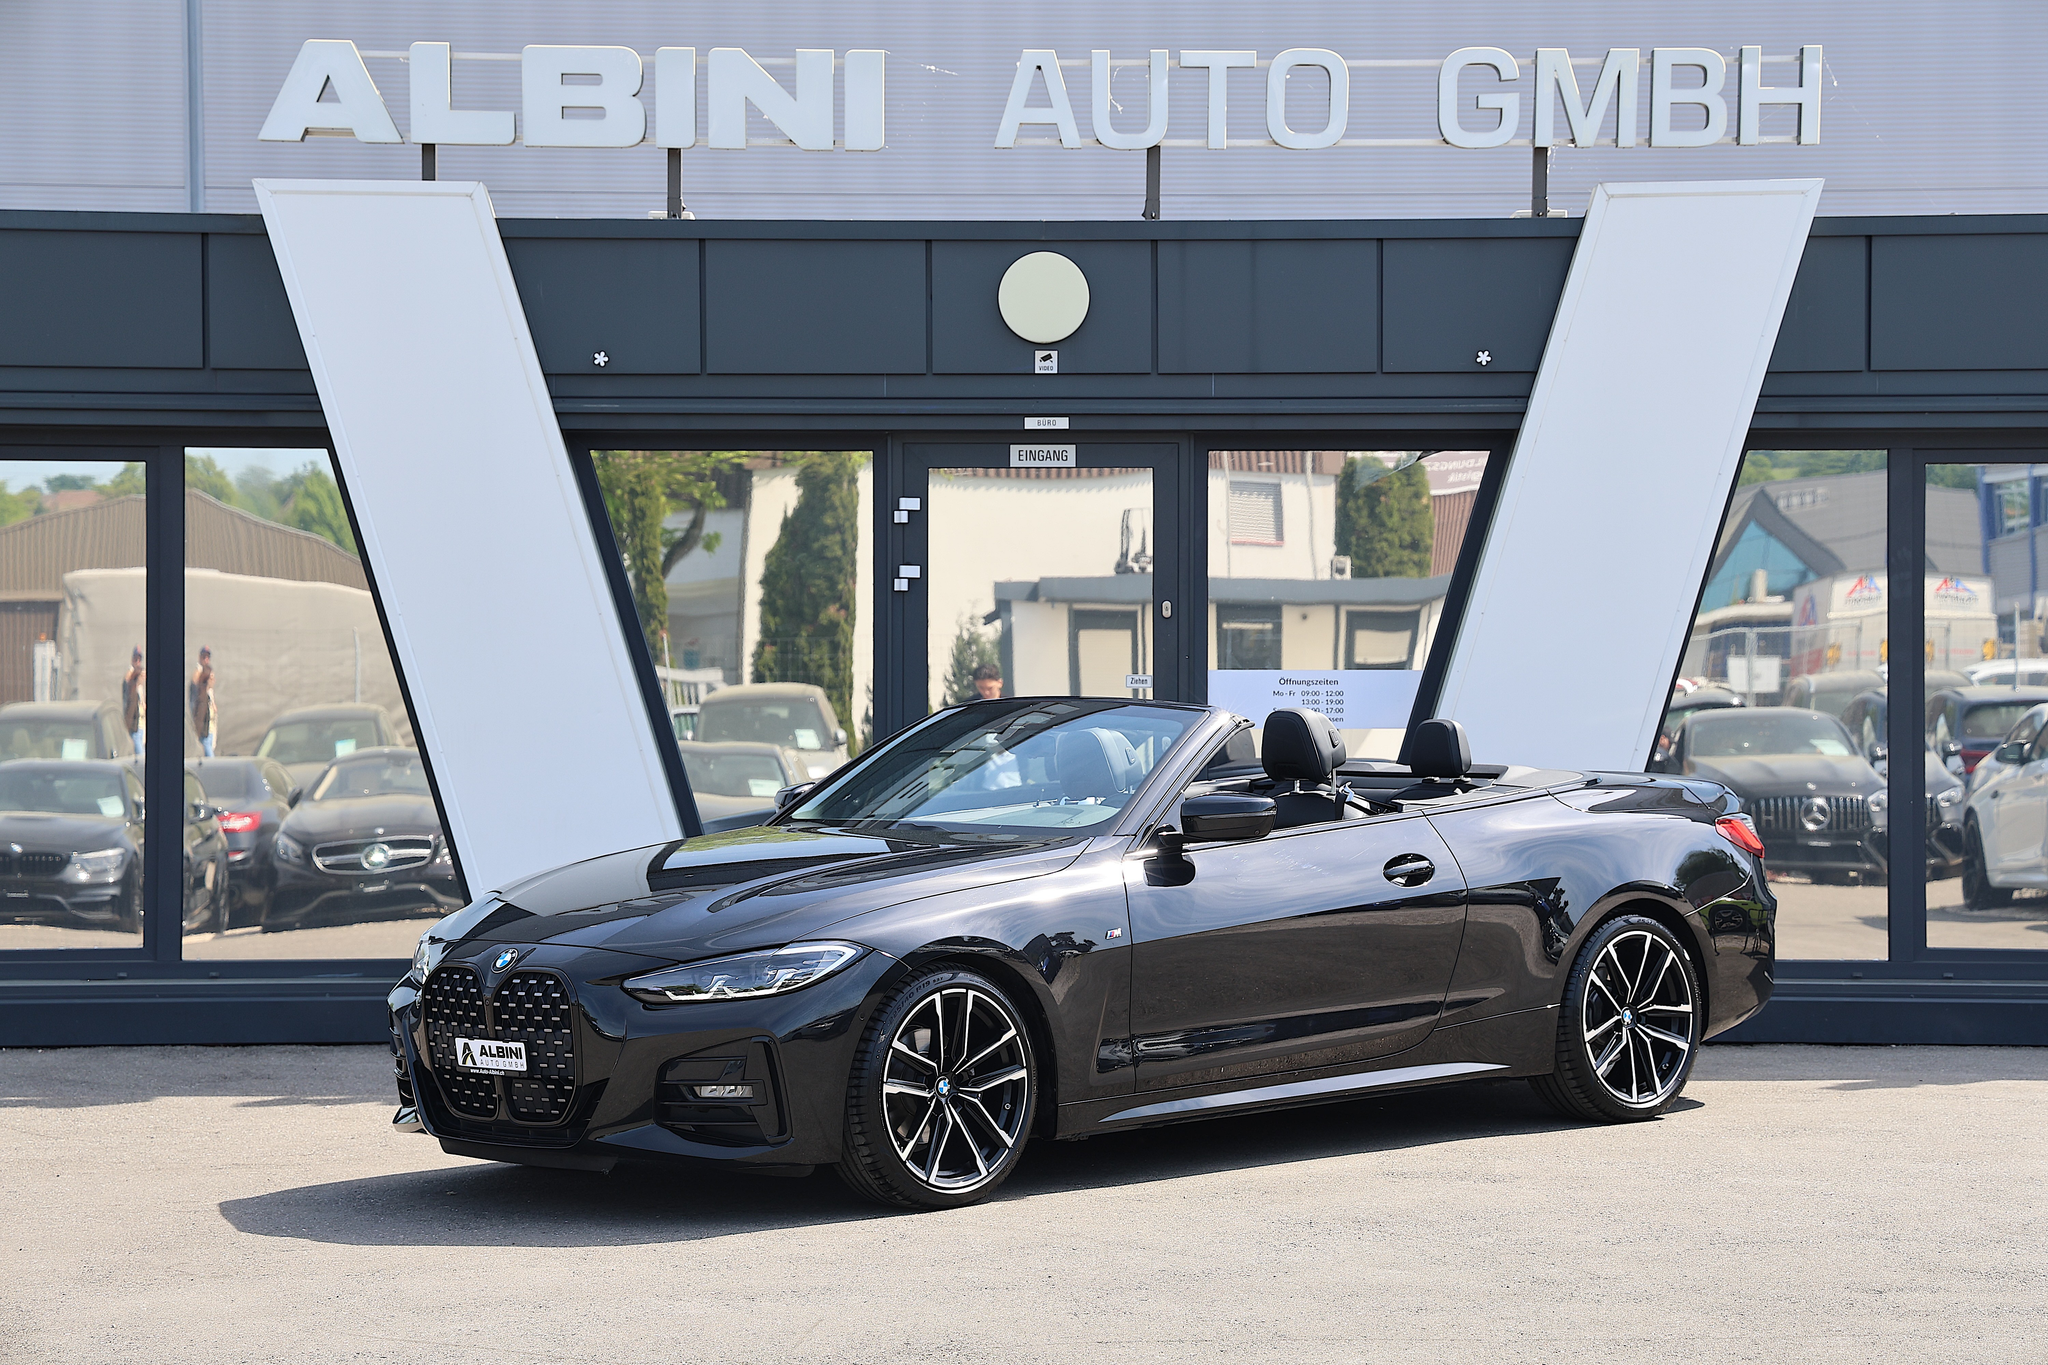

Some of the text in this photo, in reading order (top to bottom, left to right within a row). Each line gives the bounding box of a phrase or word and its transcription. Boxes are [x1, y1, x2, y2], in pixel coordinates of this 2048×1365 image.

[257, 38, 1823, 152] ALBINI AUTO GMBH
[1036, 418, 1057, 427] BÜRO
[1018, 449, 1069, 462] EINGANG
[1278, 677, 1339, 686] Öffnungszeiten
[479, 1044, 523, 1059] ALBINI
[480, 1059, 525, 1069] AUTO GMBH
